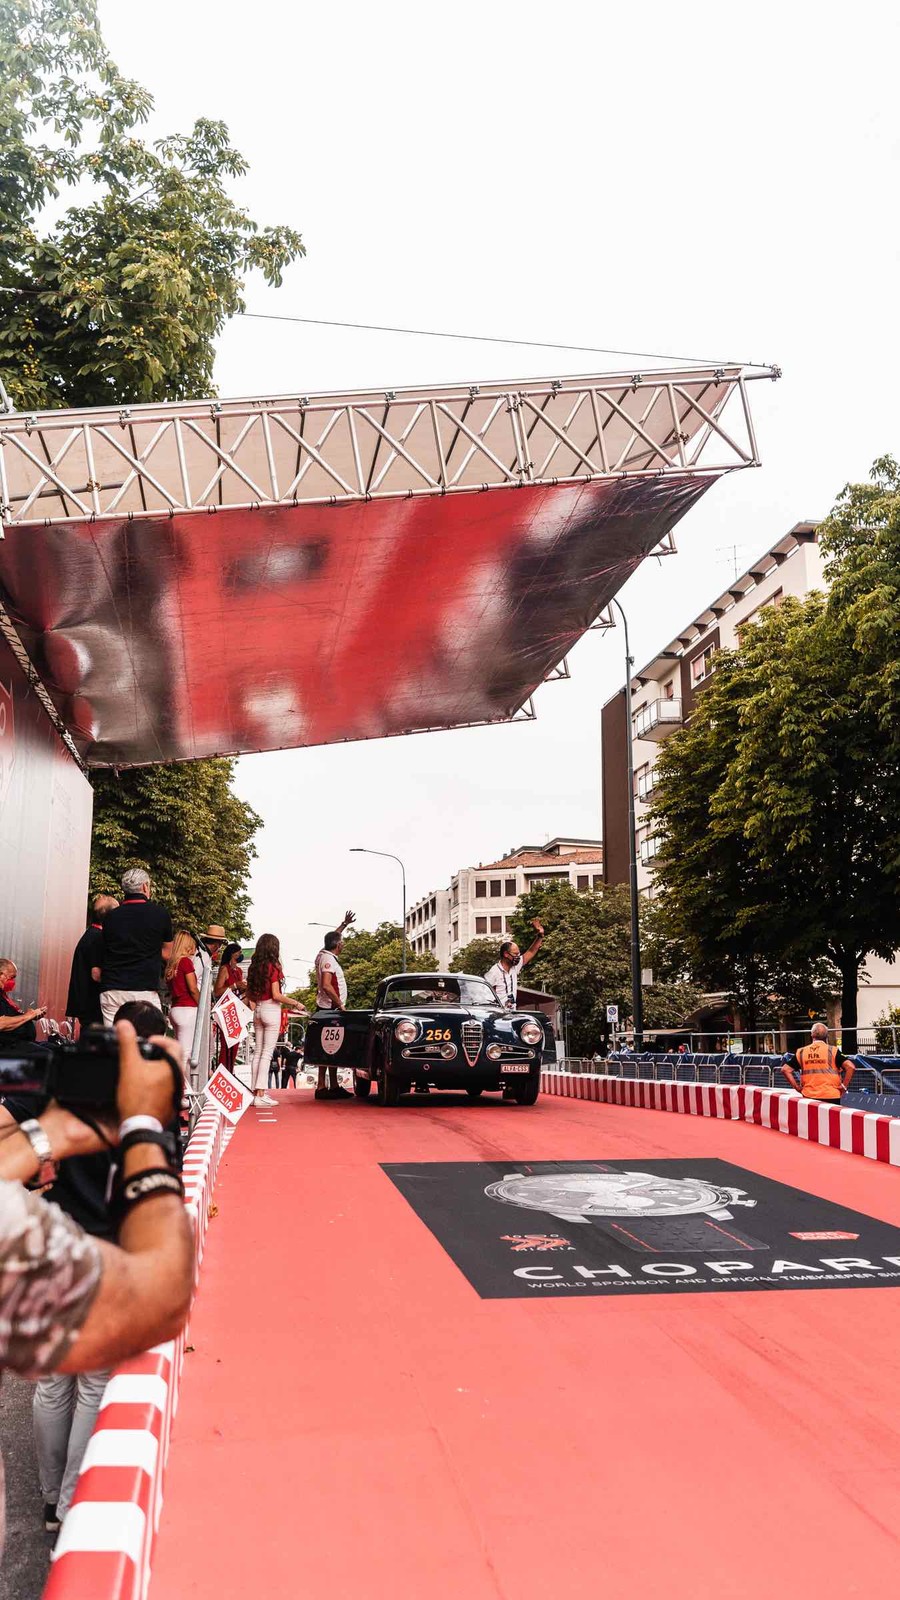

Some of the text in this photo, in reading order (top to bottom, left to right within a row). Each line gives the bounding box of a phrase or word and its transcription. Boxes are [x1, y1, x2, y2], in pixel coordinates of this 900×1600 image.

[222, 1007, 234, 1035] MIGLIA
[229, 1005, 240, 1029] 1000
[325, 1029, 340, 1041] 256
[425, 1029, 452, 1042] 256
[209, 1084, 233, 1109] MIGLIA
[217, 1076, 238, 1099] 1000
[779, 1273, 876, 1281] TIMEKEEPER
